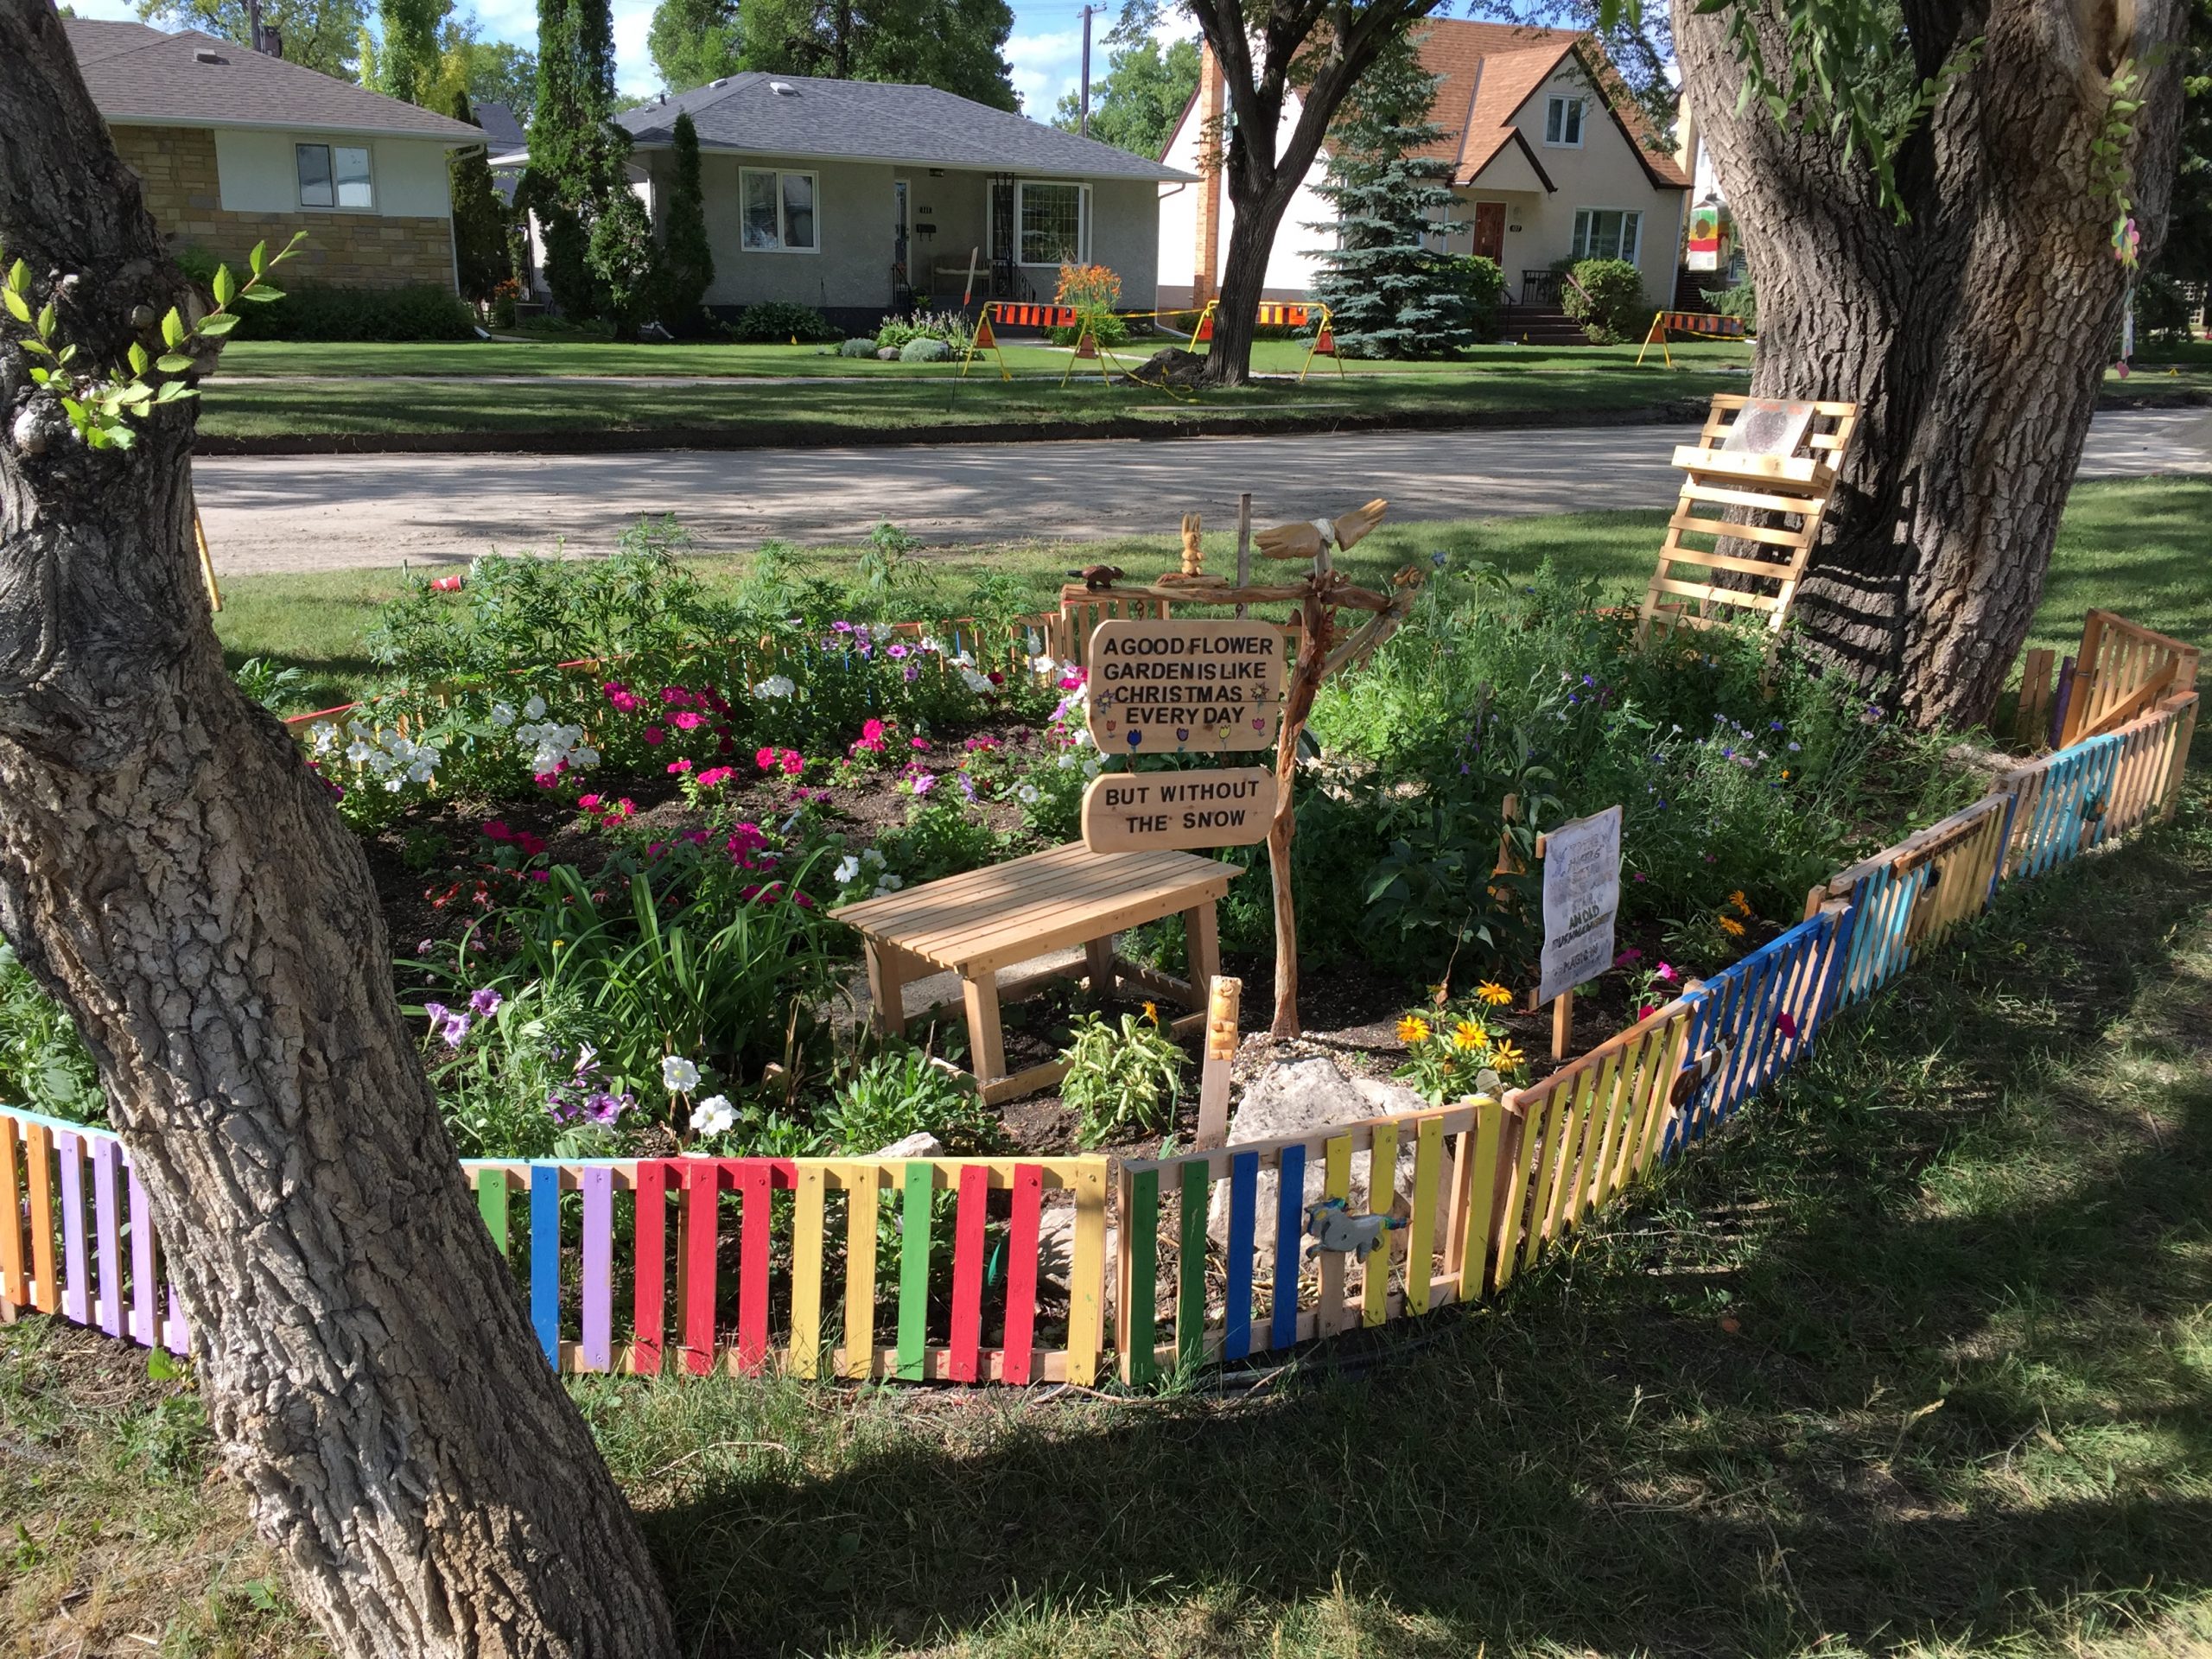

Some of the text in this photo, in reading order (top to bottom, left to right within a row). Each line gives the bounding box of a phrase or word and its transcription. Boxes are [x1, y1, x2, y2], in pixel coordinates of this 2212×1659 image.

[1103, 637, 1273, 655] A GOOD FLOWER
[1104, 662, 1266, 680] GARDEN IS LIKE
[1115, 685, 1243, 702] CHRISTMAS
[1126, 707, 1244, 724] EVERY DAY
[1106, 780, 1259, 805] BUT WITHOUT
[1126, 810, 1245, 833] THE SNOW
